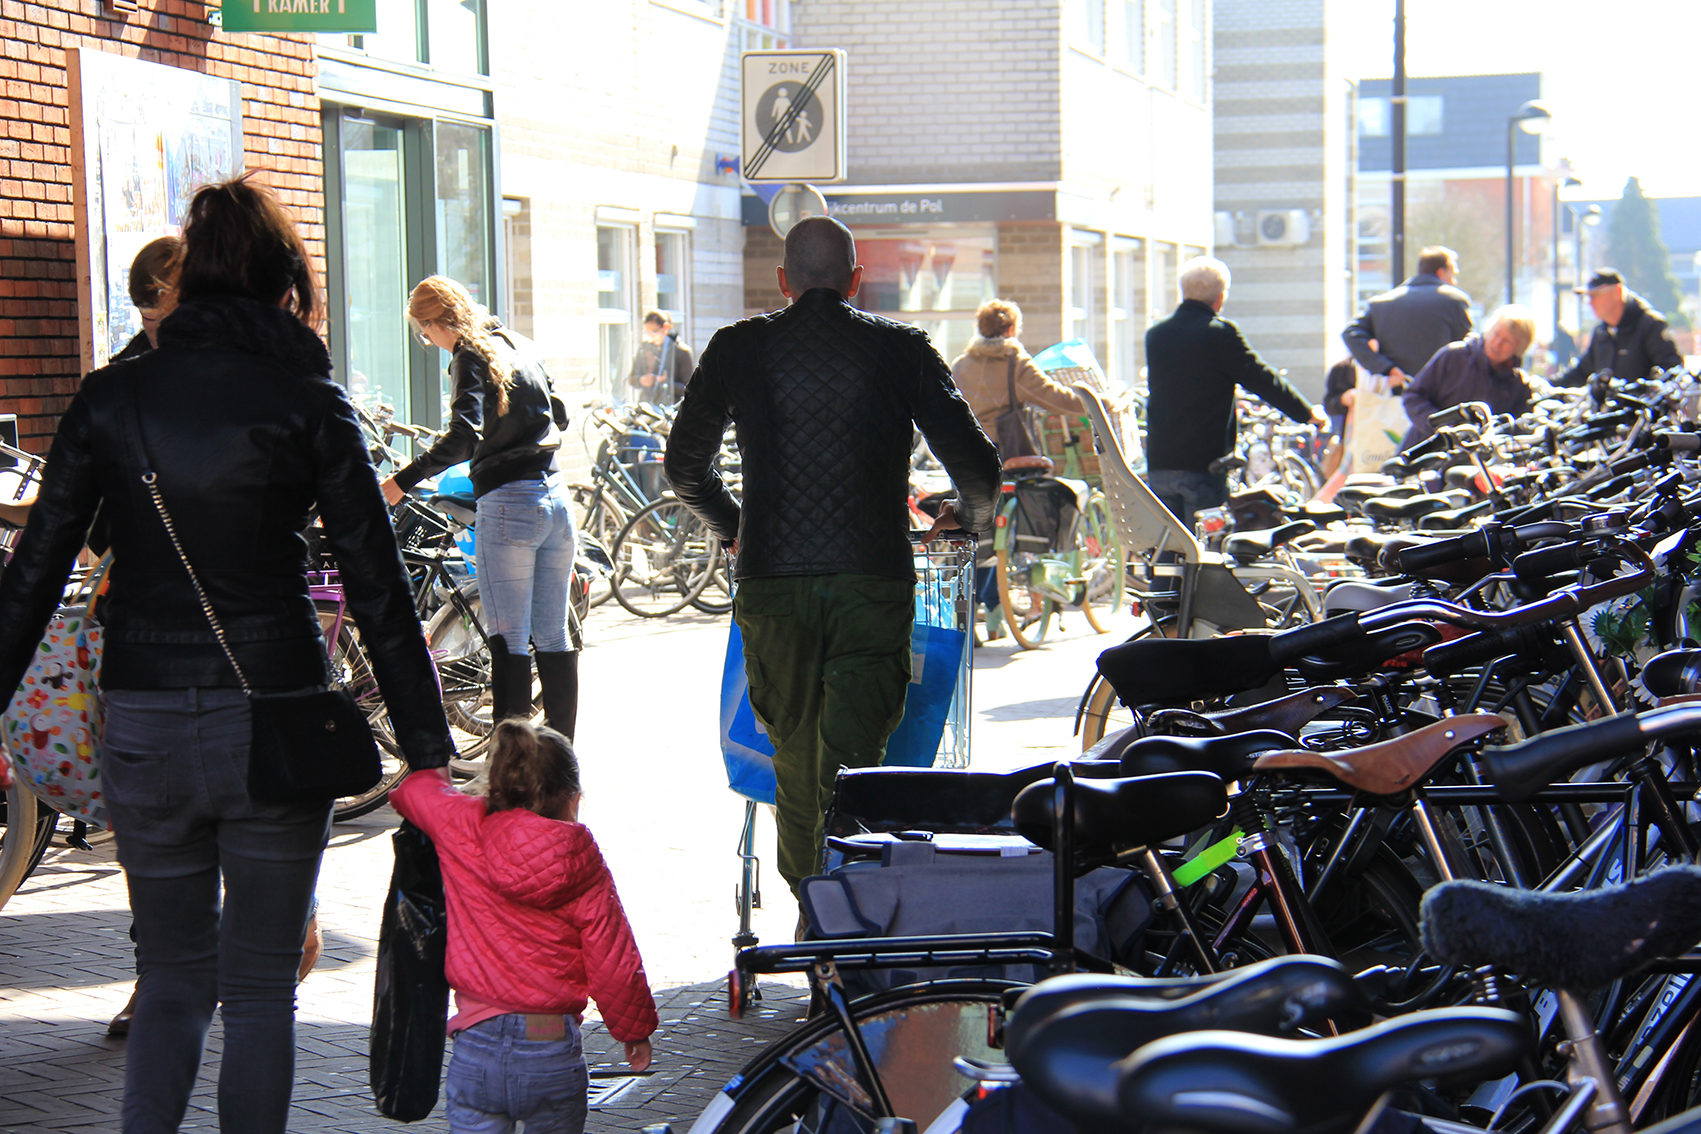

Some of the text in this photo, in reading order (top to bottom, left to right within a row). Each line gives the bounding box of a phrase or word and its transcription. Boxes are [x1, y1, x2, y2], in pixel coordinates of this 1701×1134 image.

[768, 61, 810, 74] ZONE
[827, 198, 944, 216] ijkcentrum de Pol
